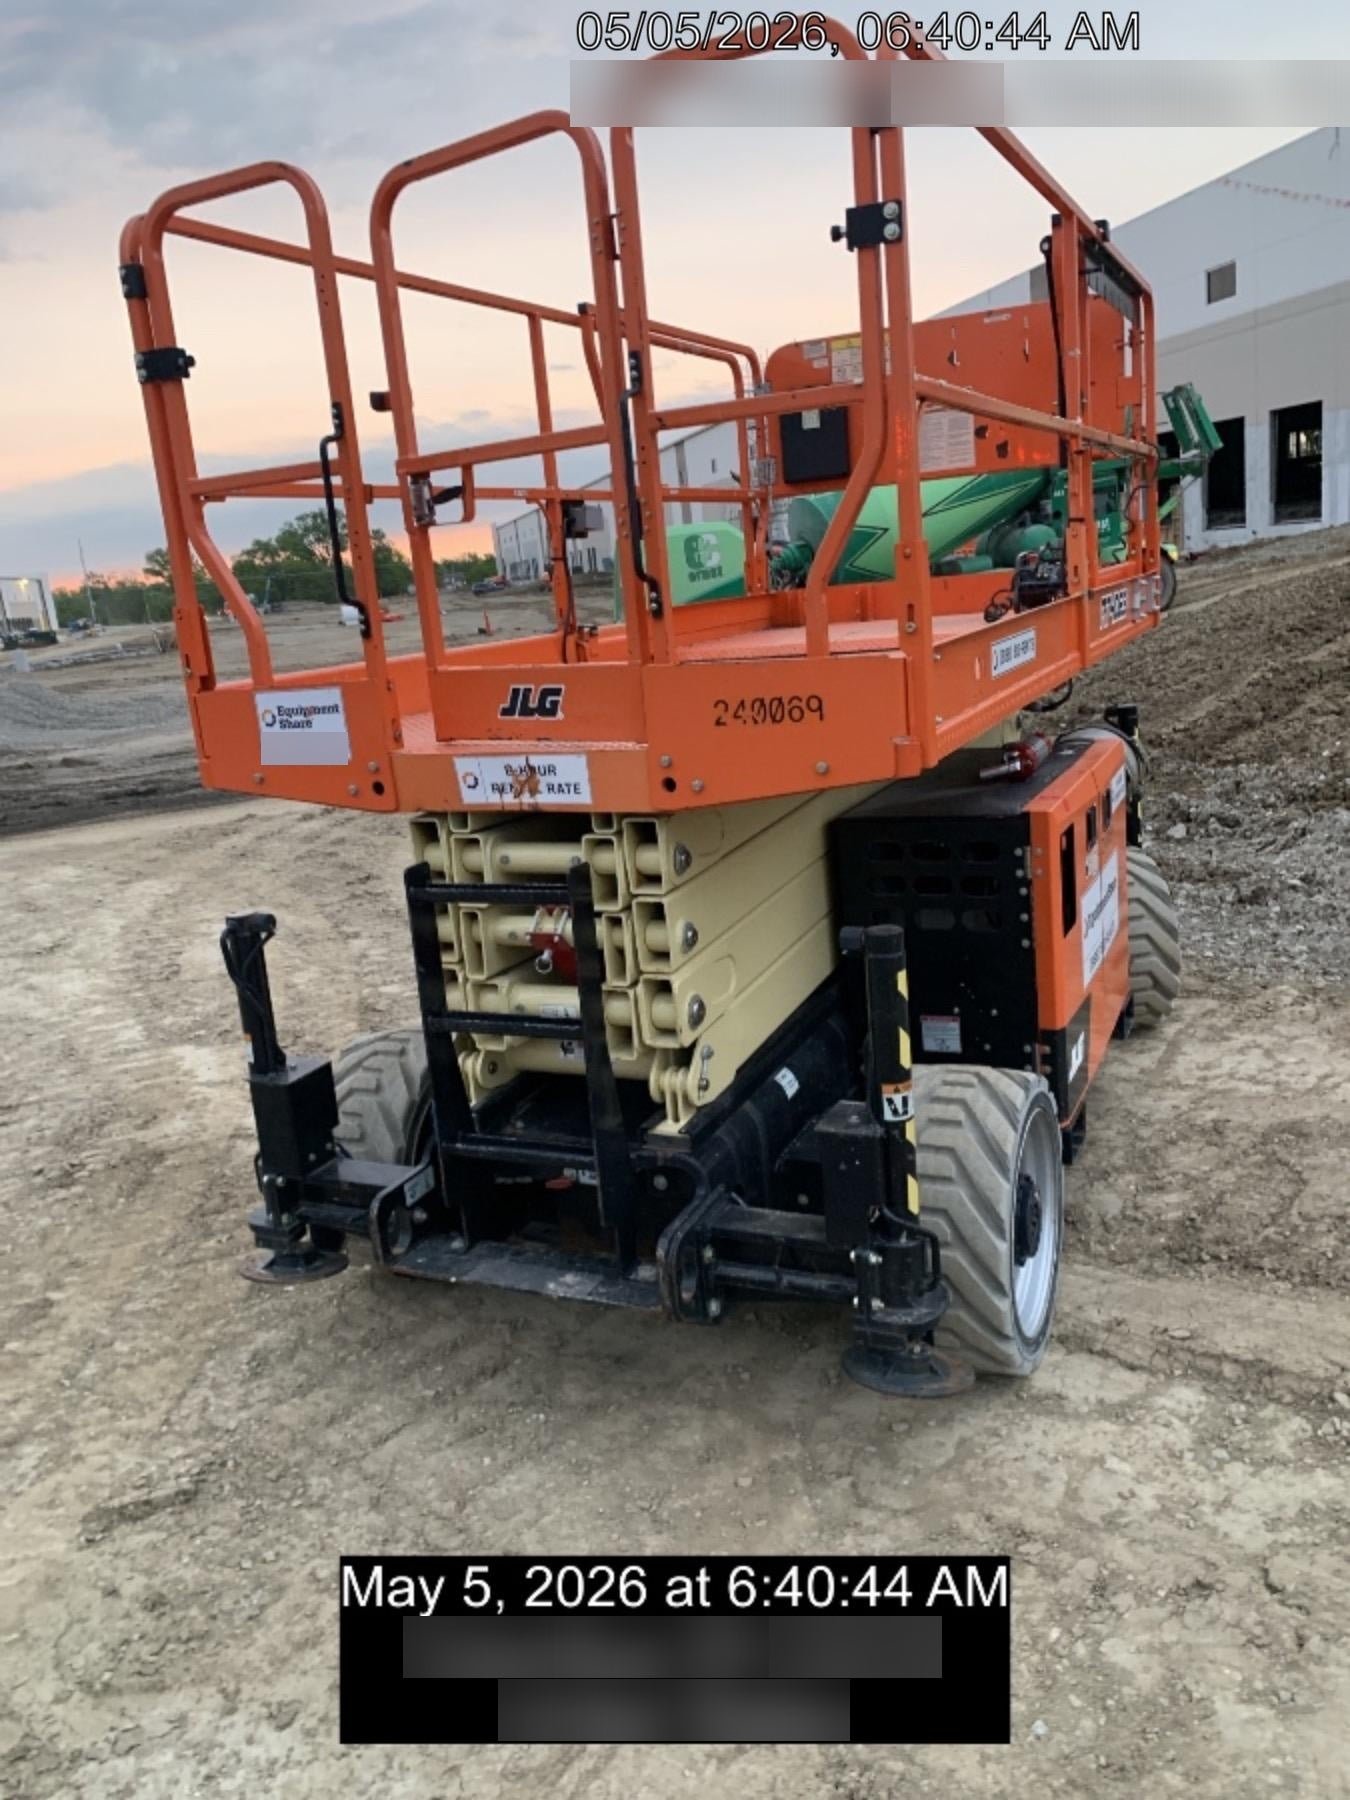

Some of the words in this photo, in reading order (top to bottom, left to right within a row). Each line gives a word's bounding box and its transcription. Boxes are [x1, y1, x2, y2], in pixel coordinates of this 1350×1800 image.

[499, 685, 564, 719] JLG
[713, 694, 824, 726] 240069
[546, 783, 582, 795] RATE
